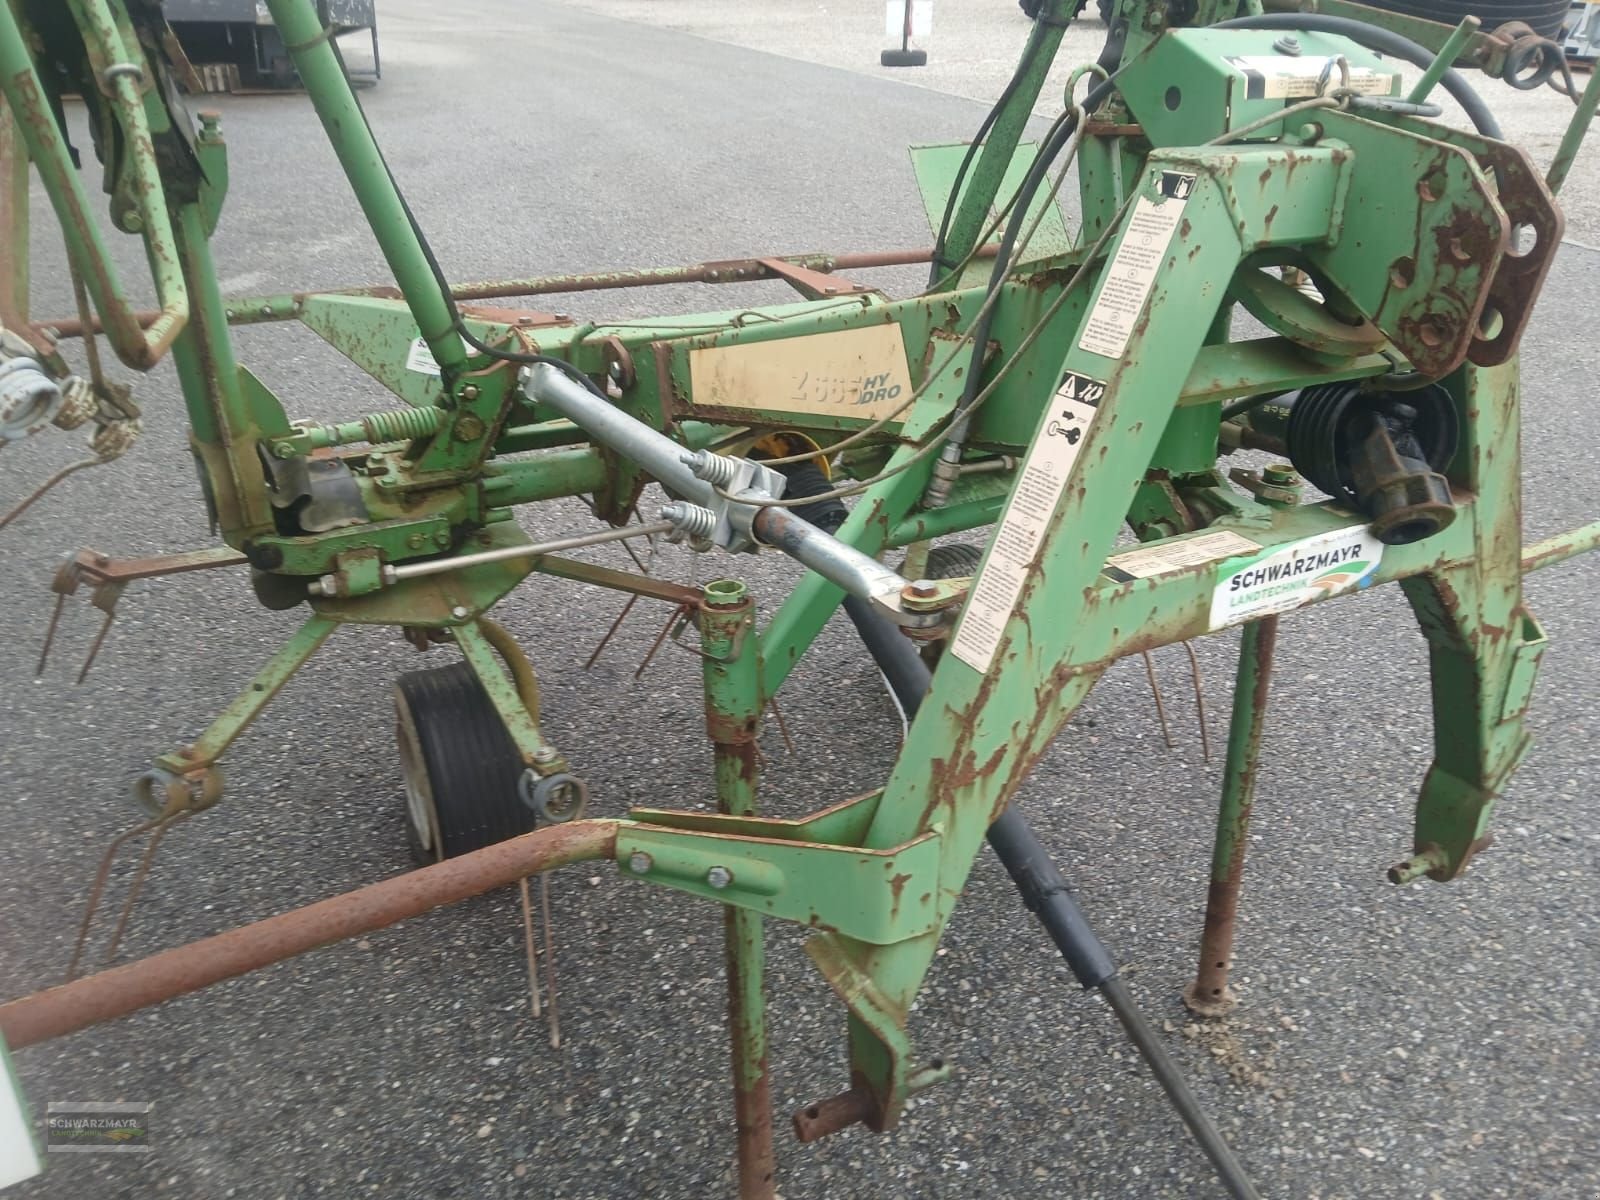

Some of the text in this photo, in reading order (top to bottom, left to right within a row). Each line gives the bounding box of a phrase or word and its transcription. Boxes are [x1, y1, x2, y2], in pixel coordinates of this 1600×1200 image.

[863, 371, 891, 391] HY
[859, 384, 901, 405] DRO
[1230, 543, 1362, 592] SCHWARZMAYR
[1230, 577, 1308, 608] LANDTECHNIK
